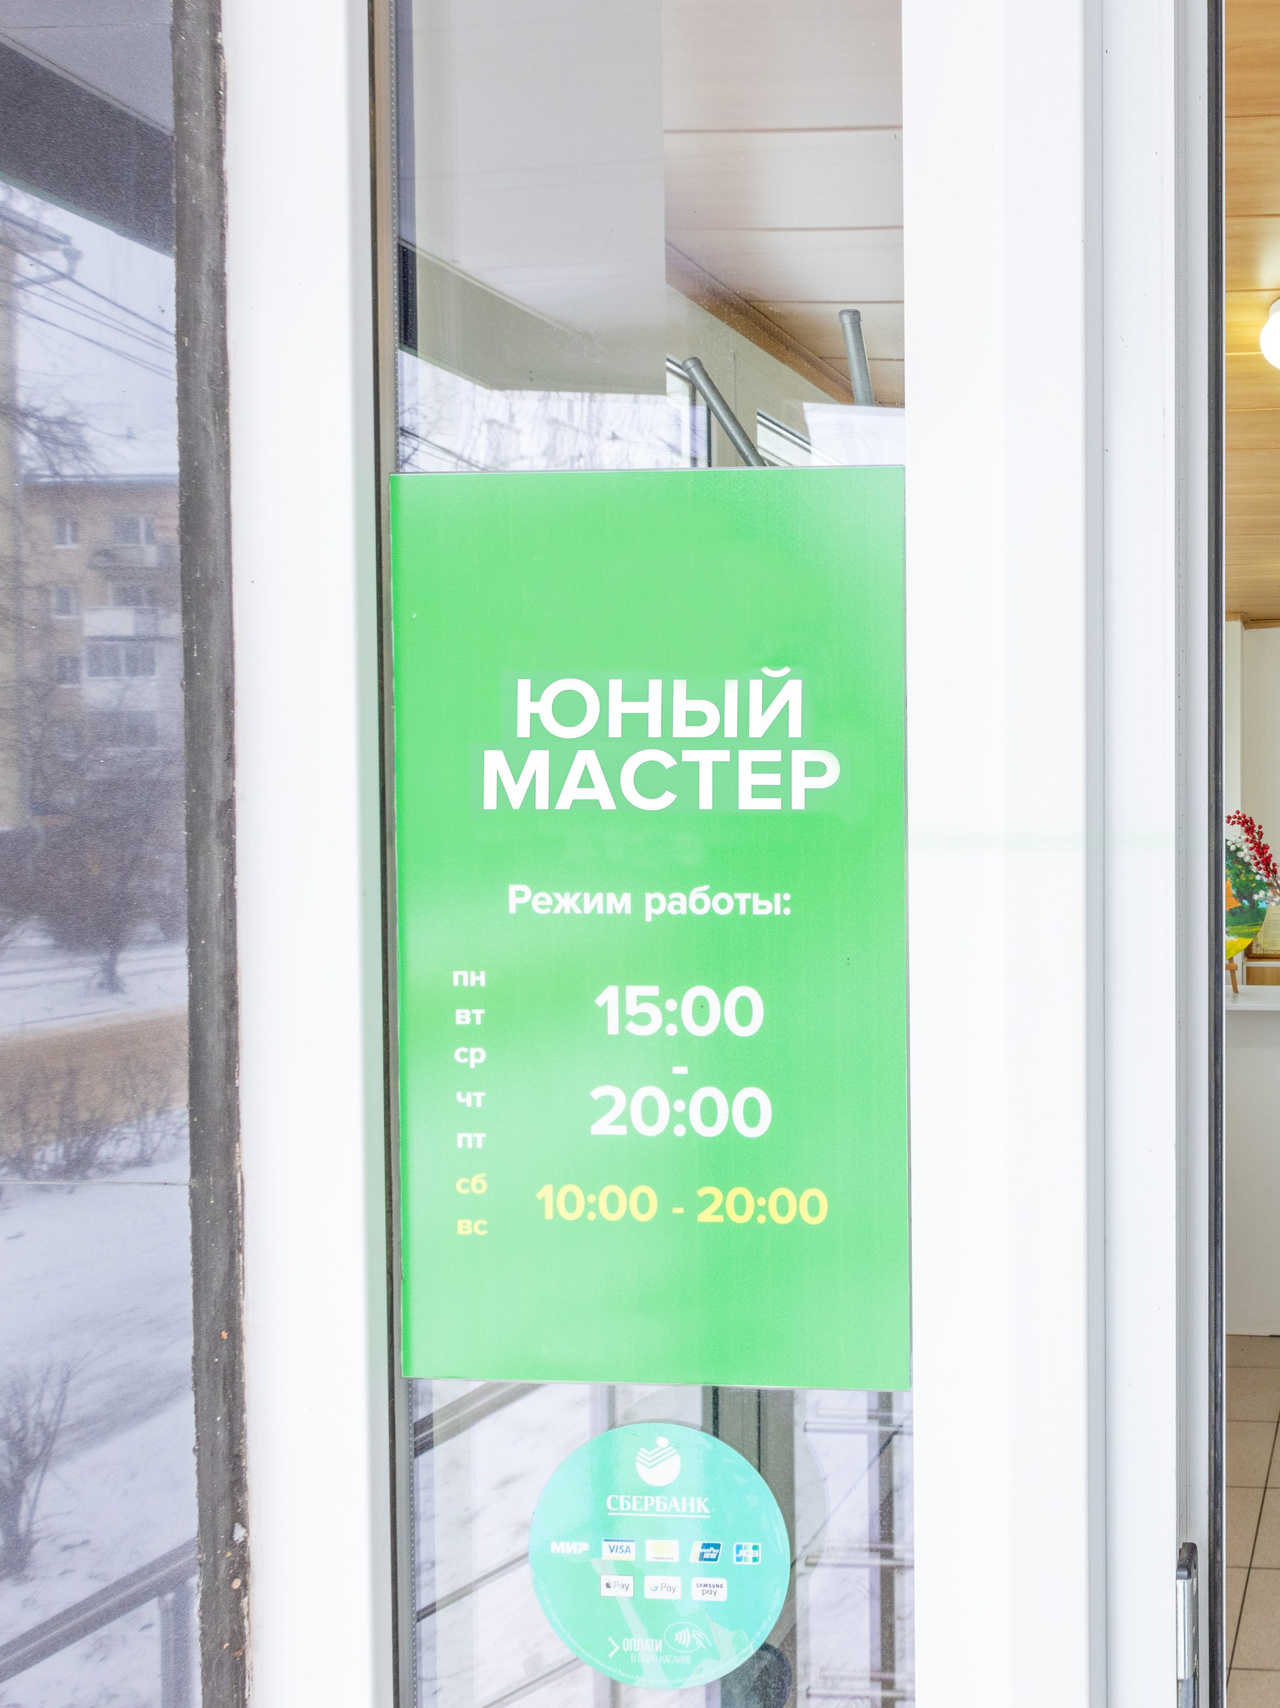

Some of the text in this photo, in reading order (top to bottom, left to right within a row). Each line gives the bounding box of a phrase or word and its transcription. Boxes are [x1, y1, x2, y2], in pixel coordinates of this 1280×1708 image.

[516, 666, 803, 739] ЮНЫЙ
[483, 749, 841, 811] МАСТЕР
[508, 884, 792, 922] Режим работы:
[452, 970, 486, 987] пн
[455, 1009, 485, 1025] вт
[594, 985, 764, 1037] 15:00
[454, 1047, 486, 1068] ср
[456, 1091, 486, 1108] чт
[589, 1085, 773, 1138] 20:00
[457, 1132, 486, 1149] пт
[455, 1173, 488, 1195] сб
[536, 1184, 658, 1222] 10:00
[696, 1186, 829, 1225] 20:00
[457, 1219, 488, 1235] вс
[606, 1494, 710, 1514] СБЕРБАНК
[551, 1541, 590, 1554] МИР
[608, 1544, 631, 1554] VISA
[736, 1549, 760, 1558] JCB
[613, 1580, 630, 1591] Pay
[660, 1582, 677, 1594] Pay
[702, 1588, 718, 1596] pay
[622, 1637, 663, 1653] ОПЛАТИ
